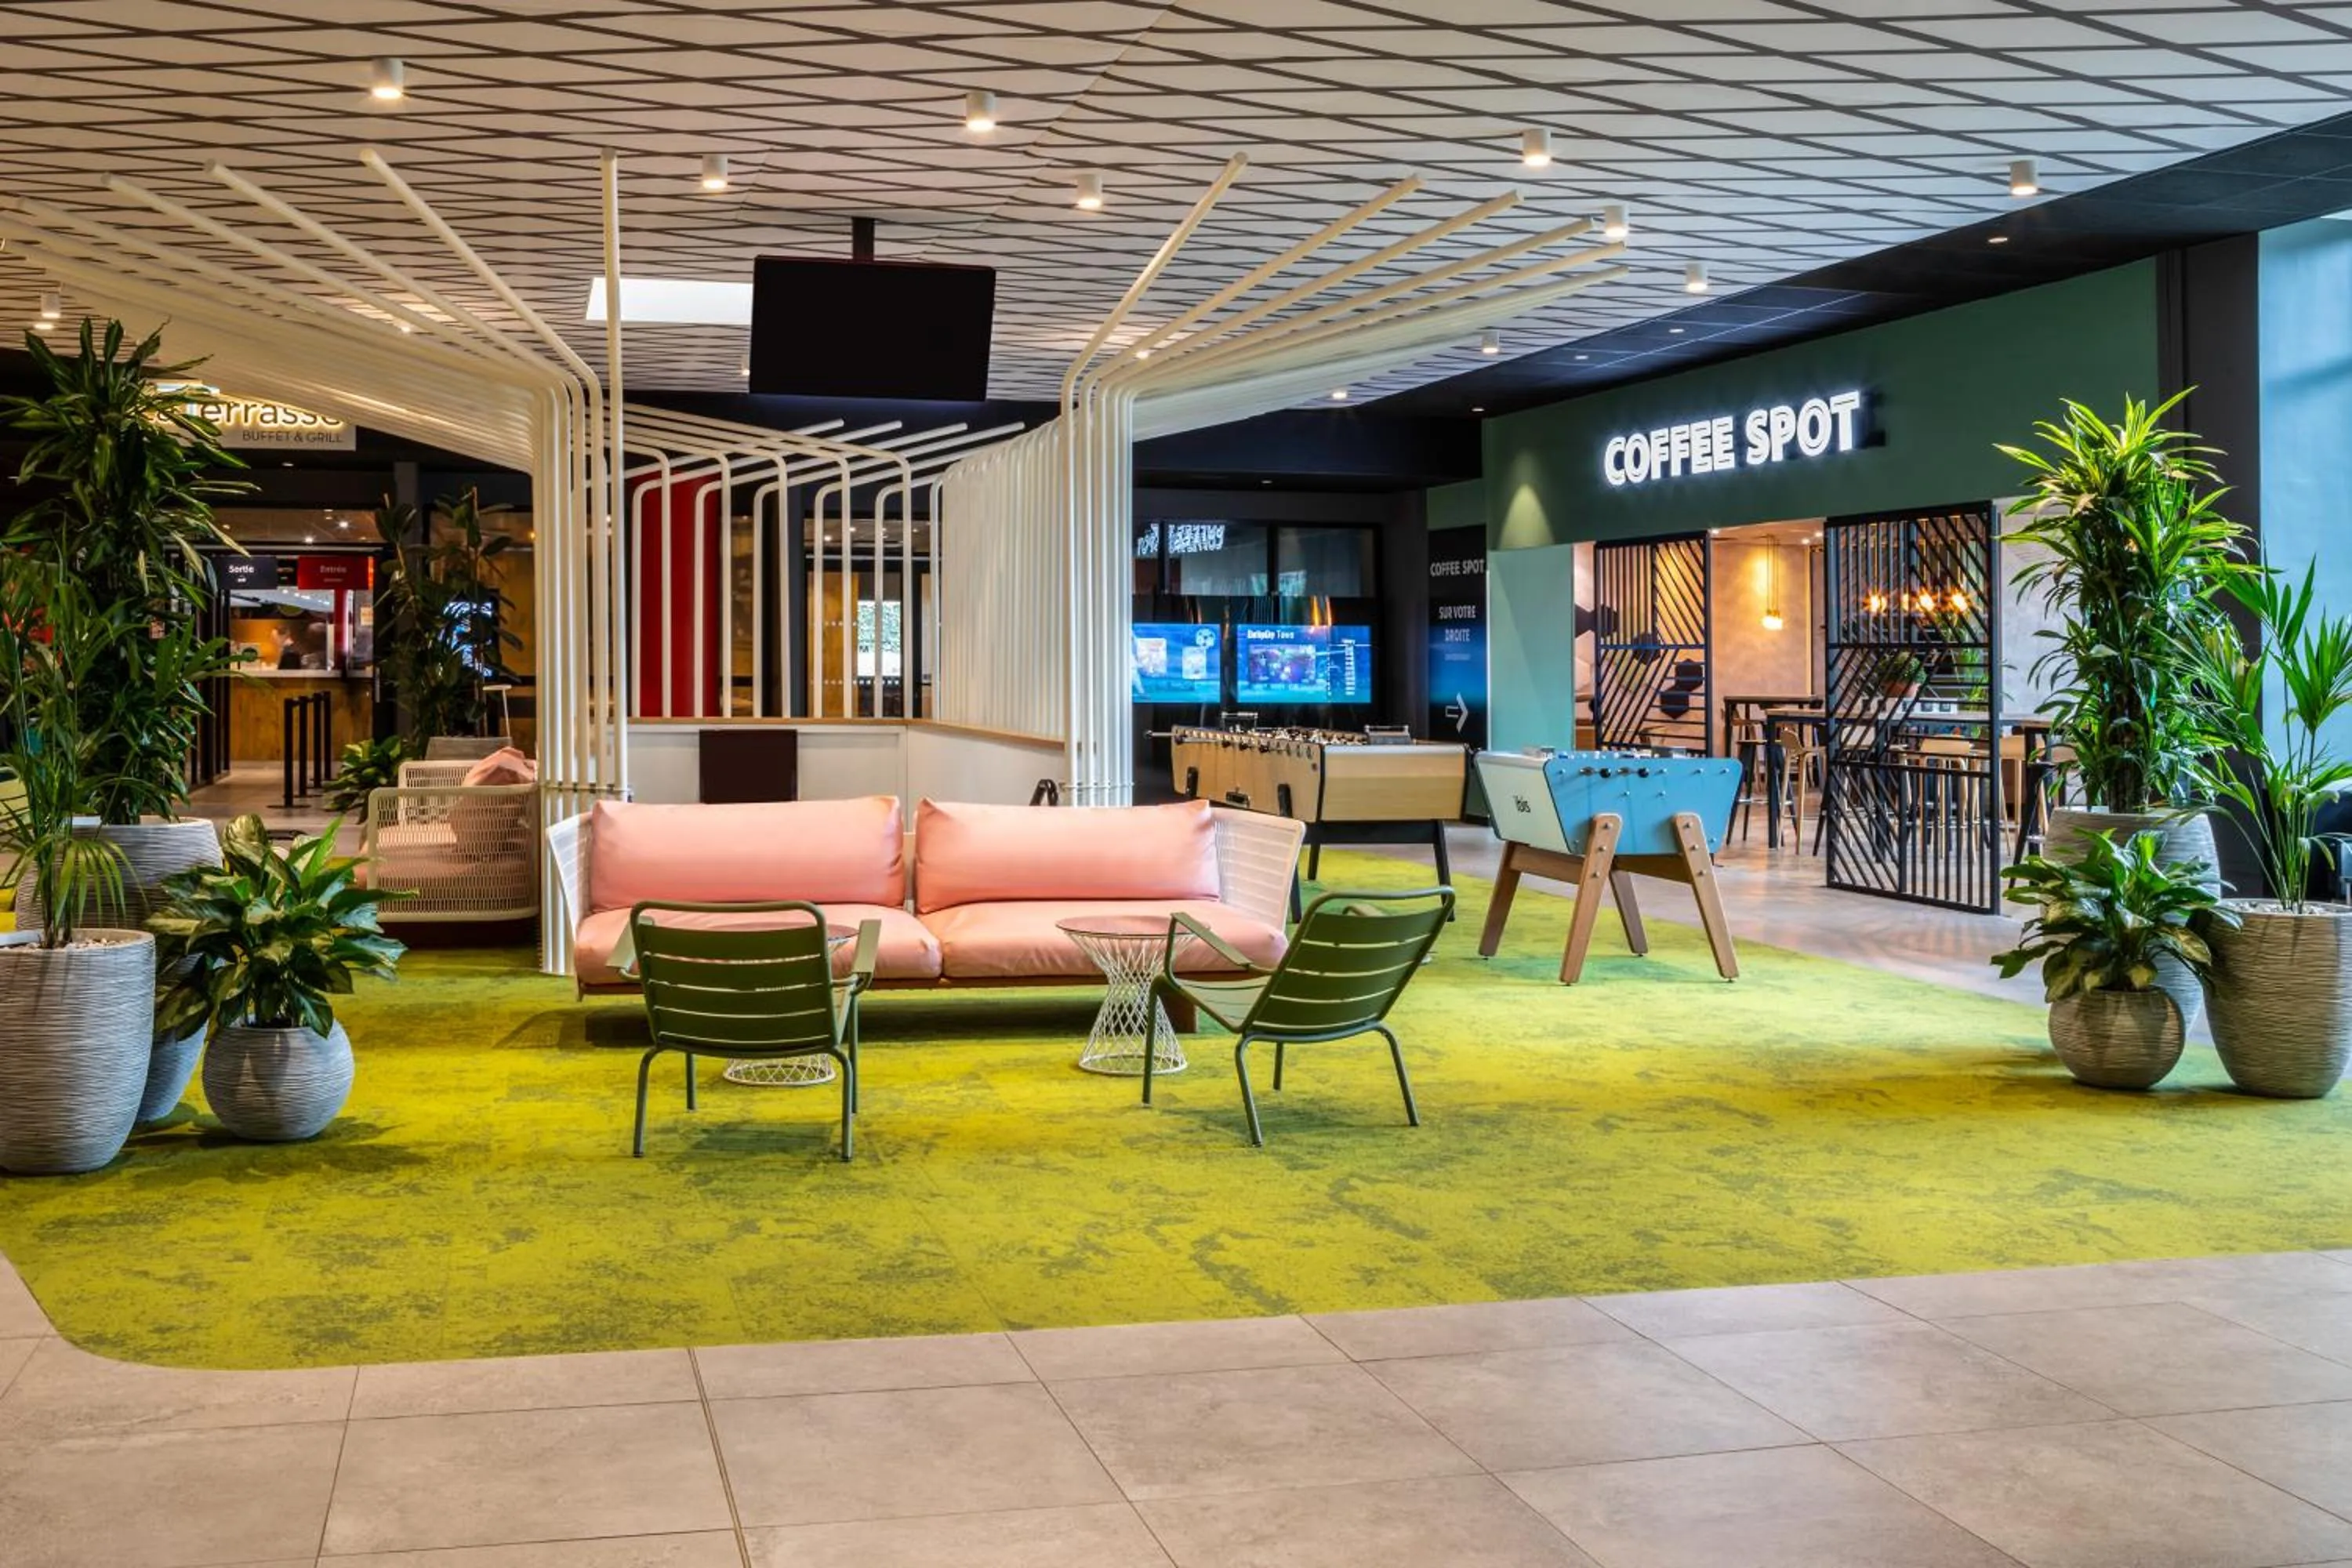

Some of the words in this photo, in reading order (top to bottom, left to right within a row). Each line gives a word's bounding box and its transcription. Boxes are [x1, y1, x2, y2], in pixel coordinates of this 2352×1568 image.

[242, 431, 289, 442] BUFFET
[294, 432, 303, 442] &
[306, 432, 343, 442] GRILL
[1604, 416, 1735, 486] COFFEE
[1745, 390, 1860, 465] SPOT
[1430, 560, 1460, 576] COFFEE
[1462, 559, 1484, 575] SPOT
[1439, 606, 1453, 619] SUR
[1454, 605, 1476, 619] VOTRE
[1445, 629, 1470, 642] DROITE
